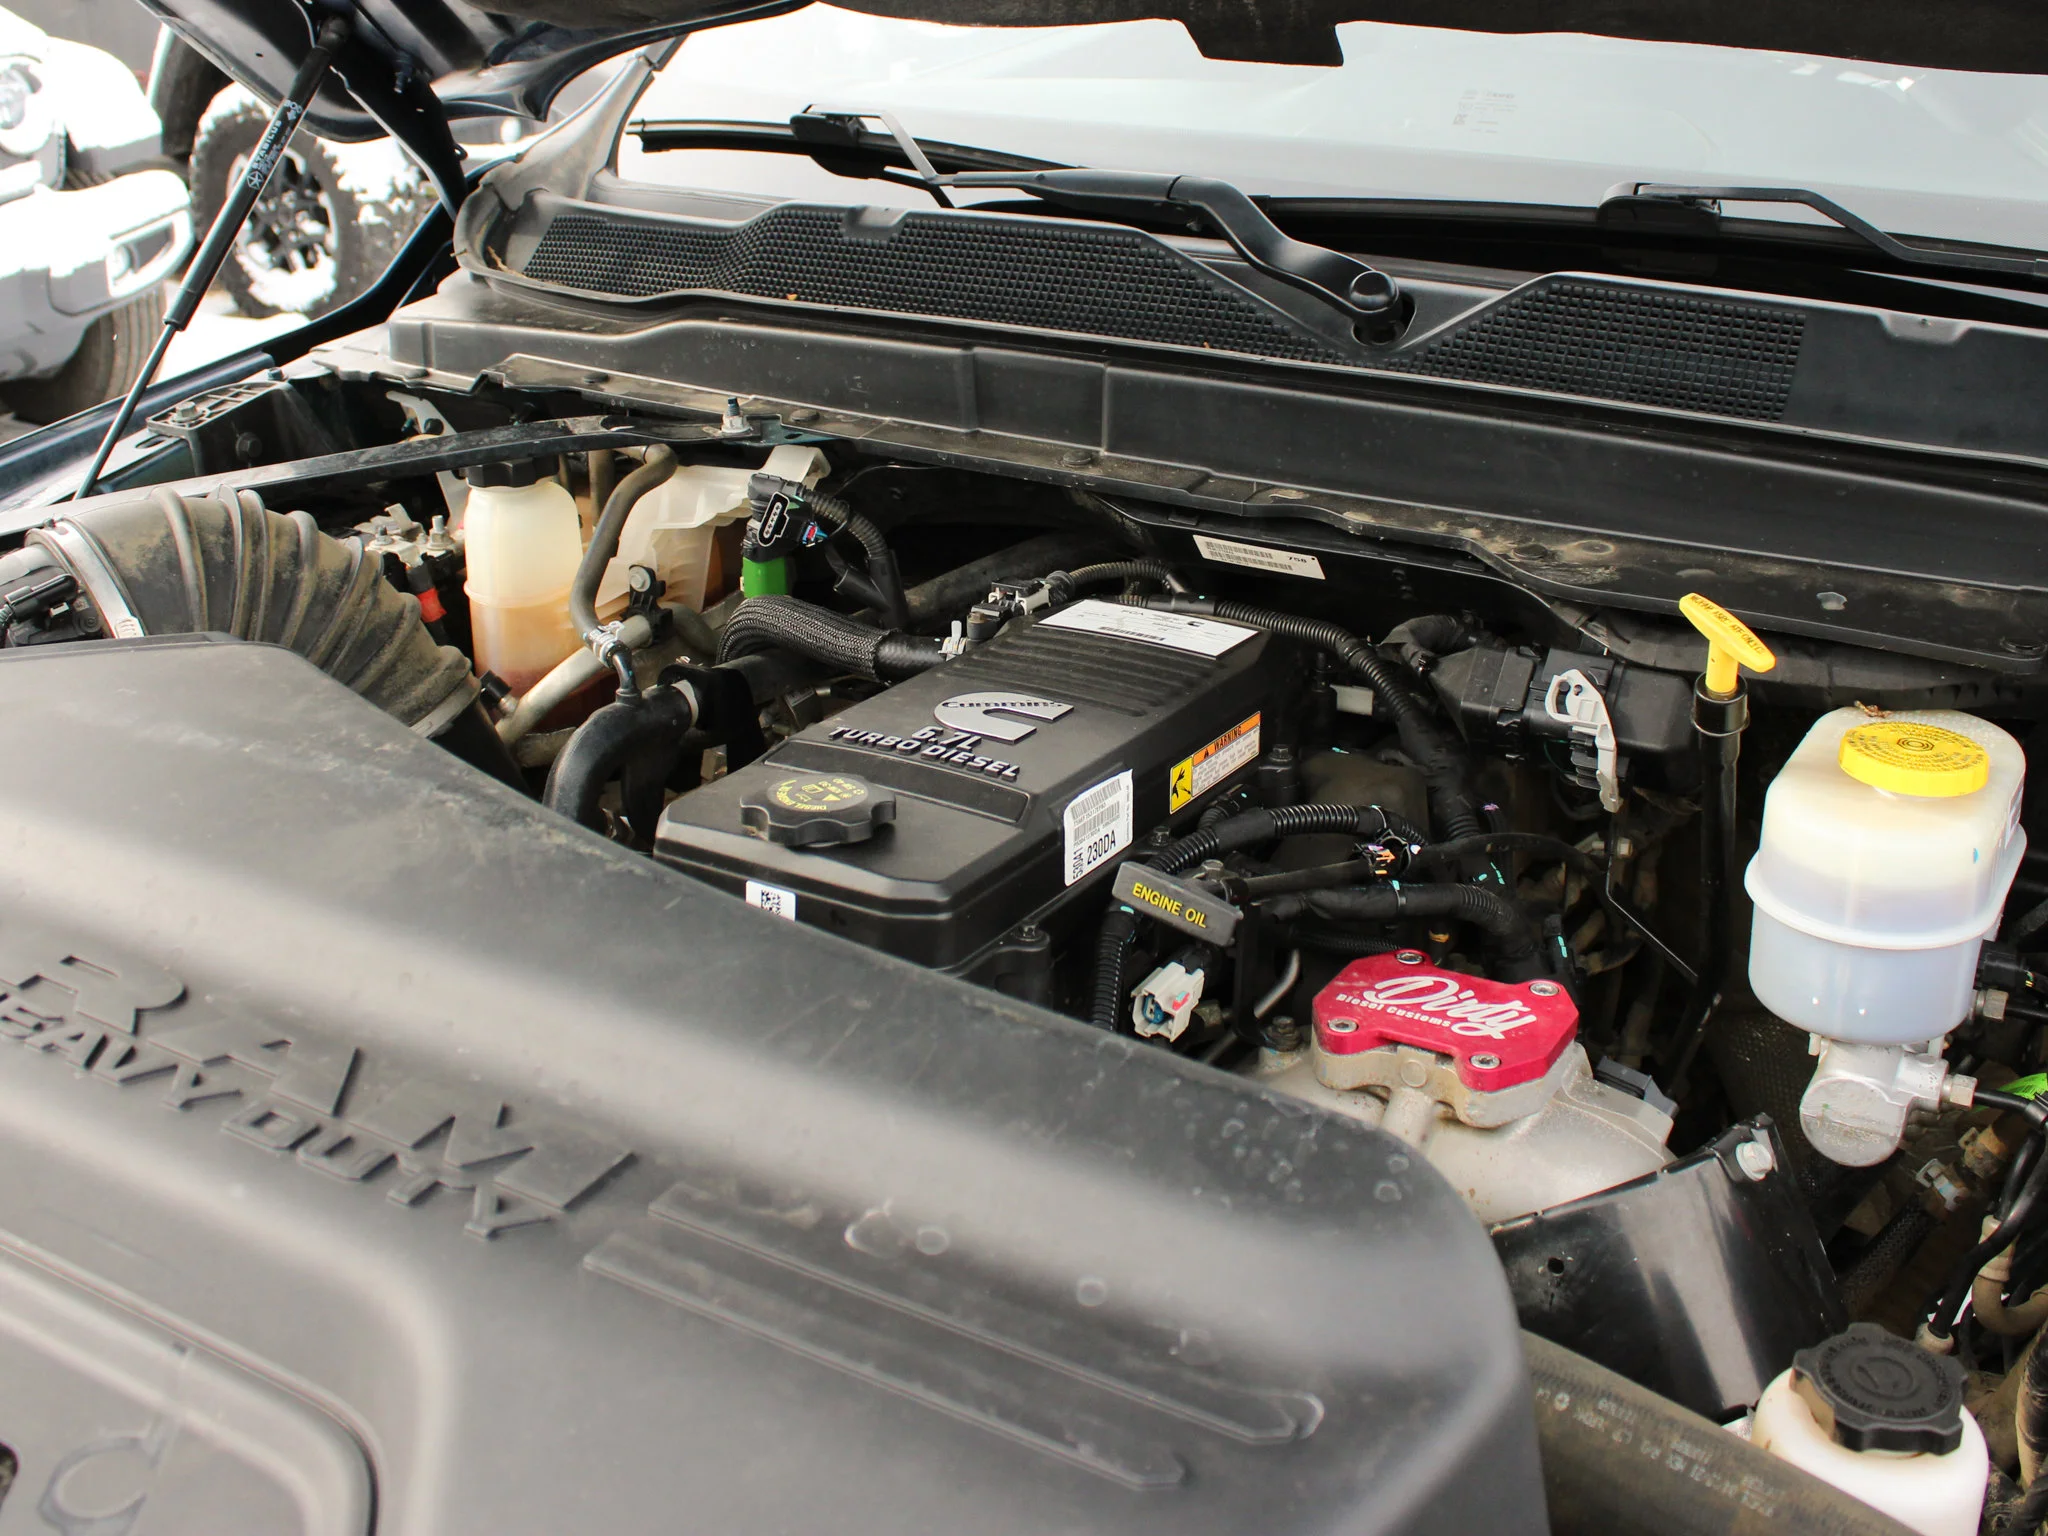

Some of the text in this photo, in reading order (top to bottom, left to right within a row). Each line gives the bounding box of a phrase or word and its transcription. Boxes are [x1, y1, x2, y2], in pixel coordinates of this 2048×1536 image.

[828, 727, 1020, 781] TURBO DIESEL
[912, 726, 982, 751] 6.7L
[1214, 726, 1242, 751] WARNING
[1072, 847, 1084, 880] 53041
[1086, 829, 1117, 865] 230DA
[1132, 882, 1207, 929] ENGINE OIL
[1335, 993, 1451, 1028] Diesel Customs
[1363, 976, 1538, 1039] Dirty
[0, 938, 638, 1212] RAM
[0, 988, 560, 1240] EAVY DUTY
